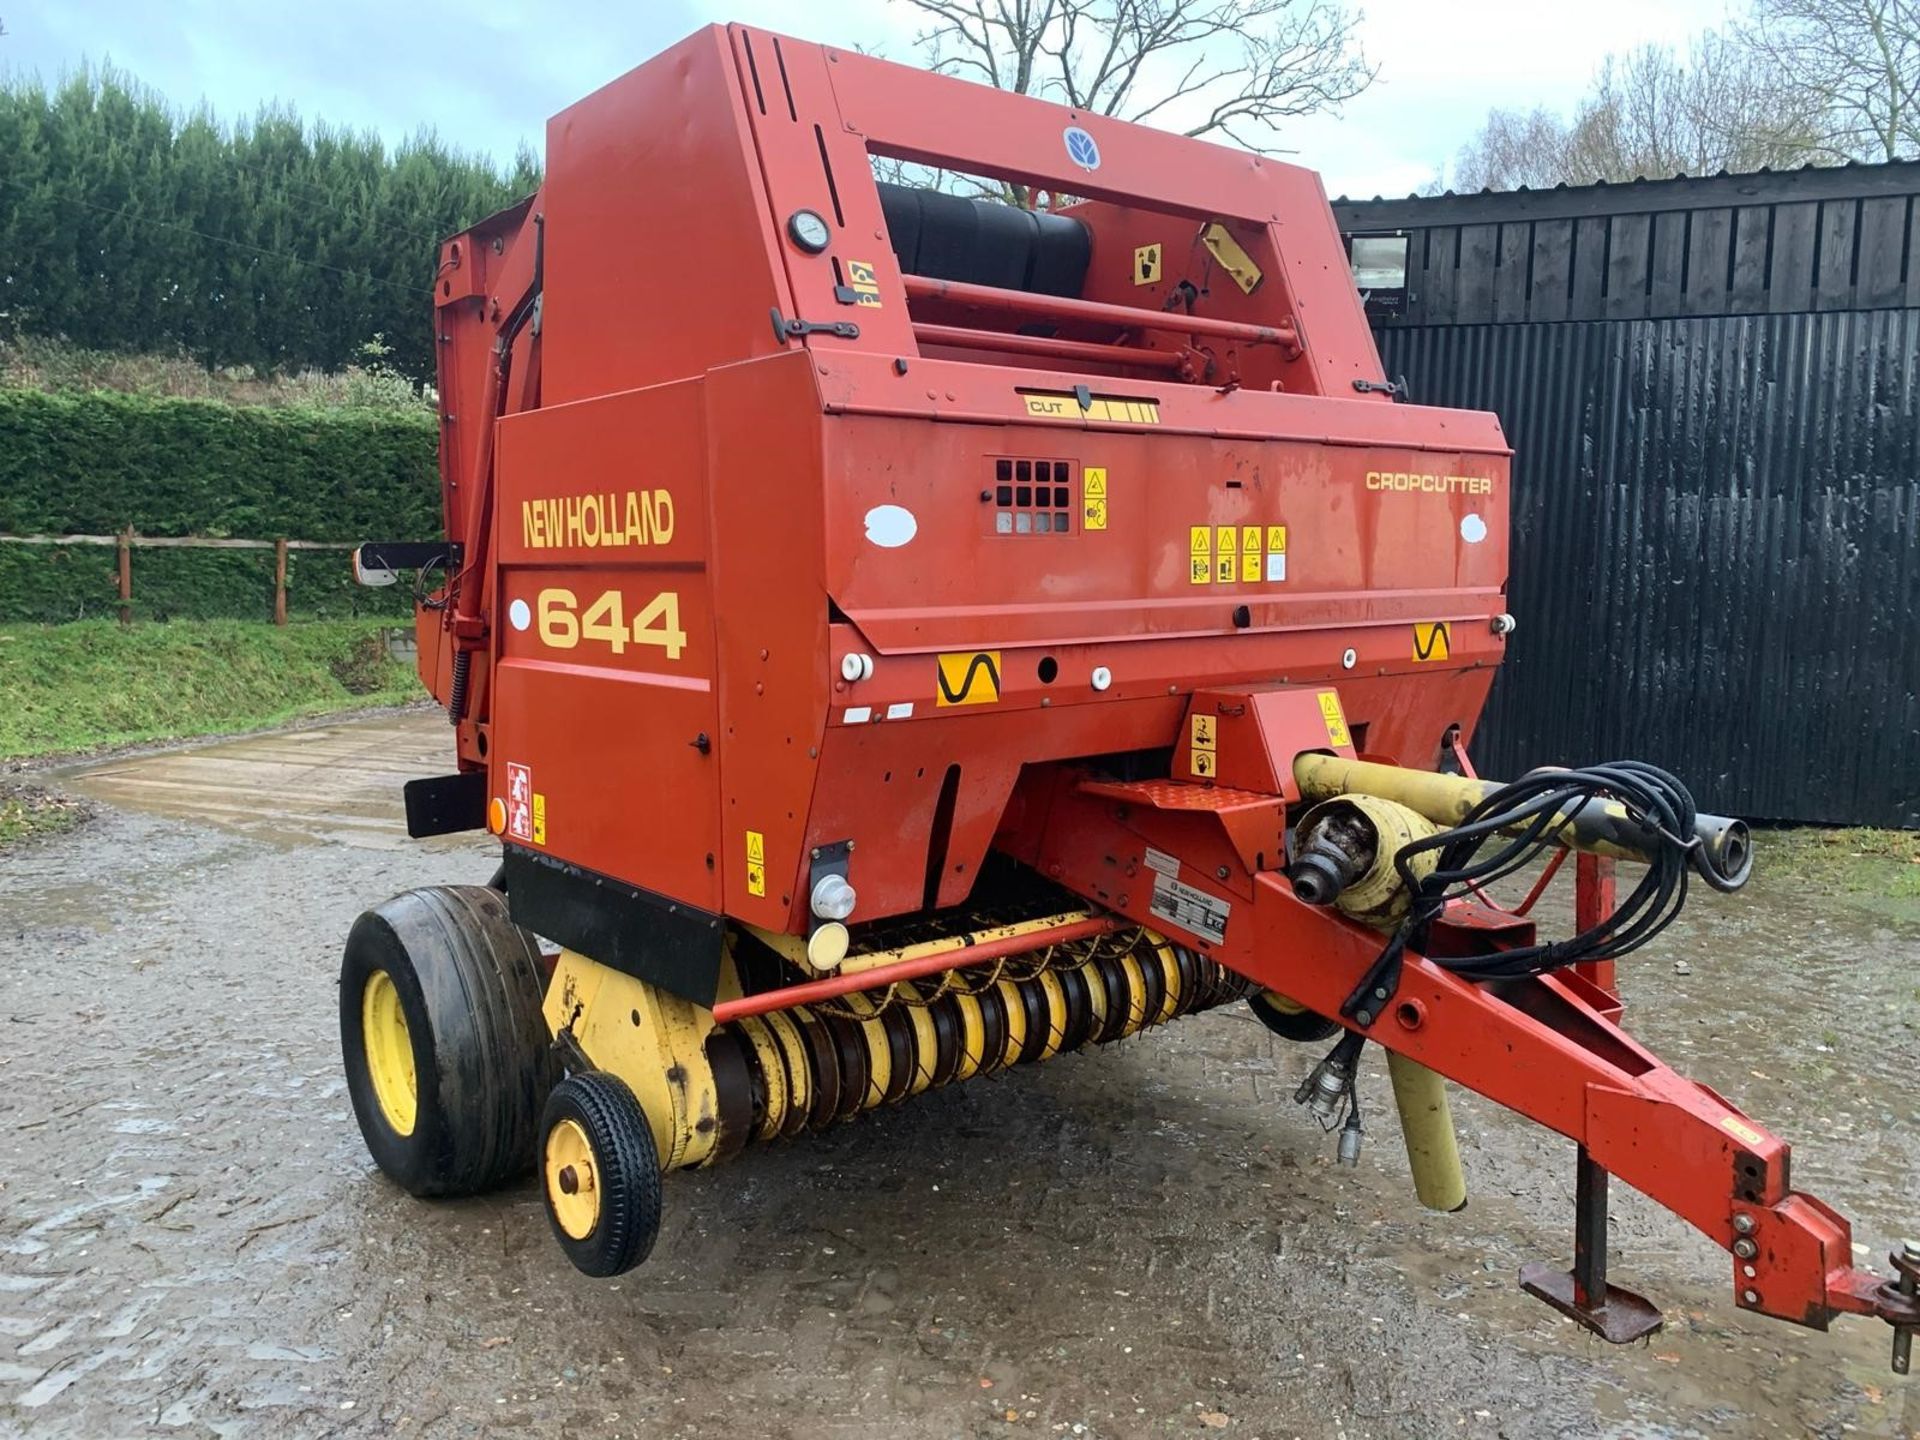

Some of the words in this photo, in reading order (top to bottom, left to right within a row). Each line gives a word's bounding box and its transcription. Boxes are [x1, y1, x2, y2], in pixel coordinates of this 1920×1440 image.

[1030, 401, 1062, 413] CUT
[1366, 471, 1491, 494] CROPCUTTER
[538, 588, 687, 659] 644
